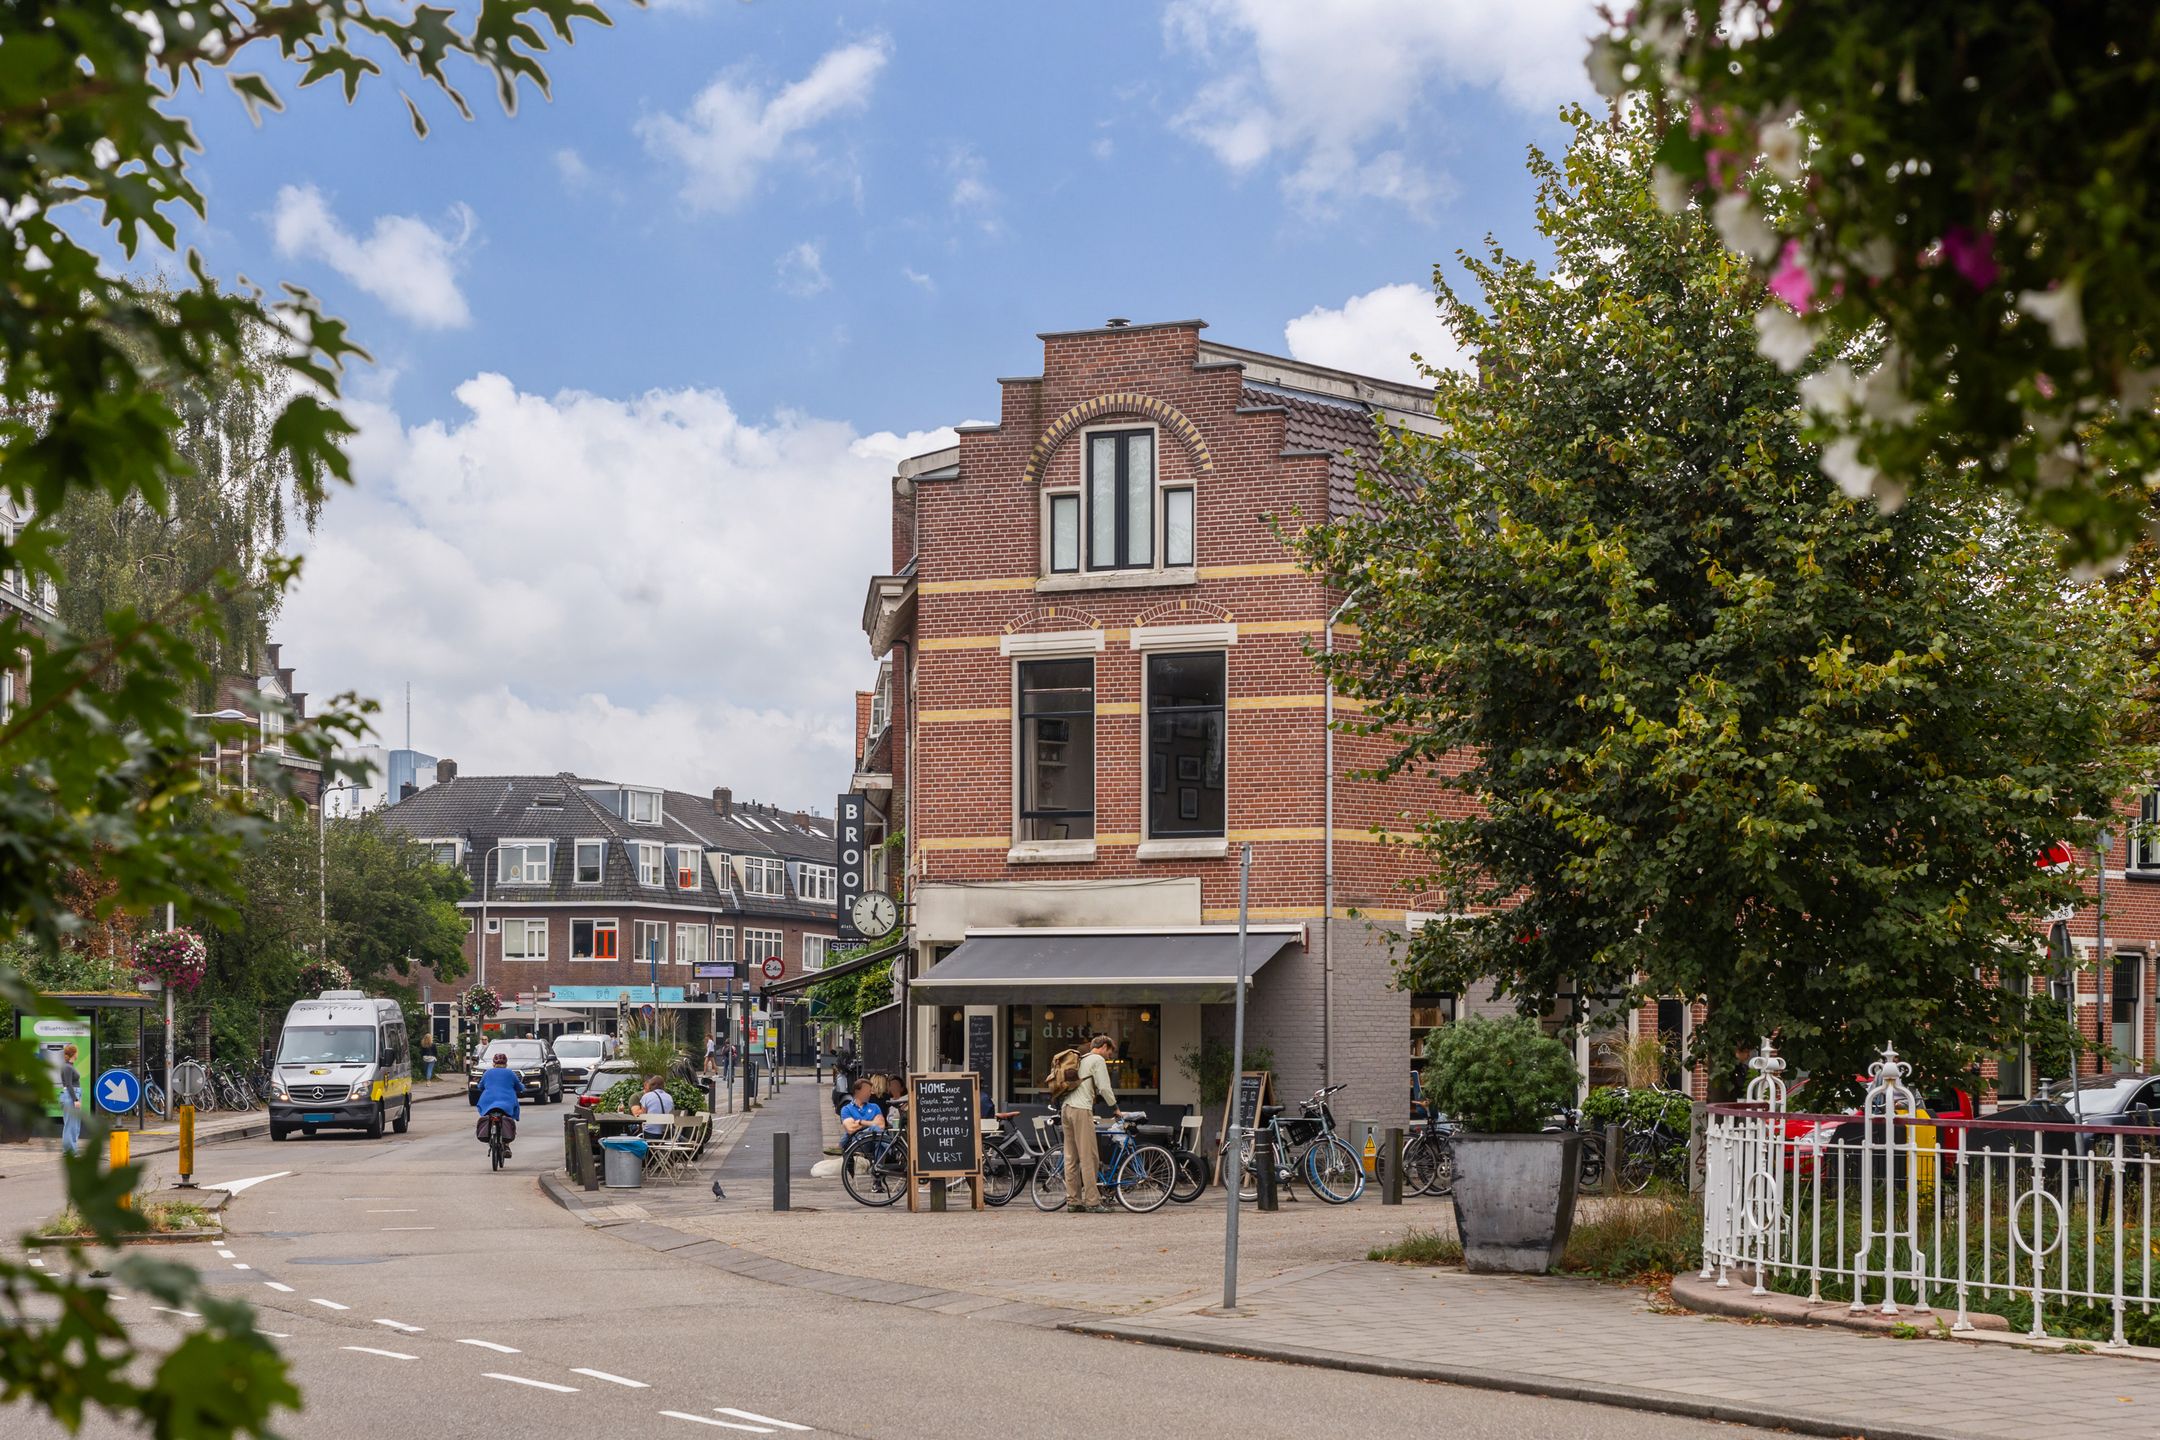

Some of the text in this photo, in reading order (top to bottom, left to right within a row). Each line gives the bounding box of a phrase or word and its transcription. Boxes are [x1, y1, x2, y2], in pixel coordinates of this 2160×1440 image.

[842, 803, 859, 911] BROOD
[831, 942, 867, 951] SEIKO
[920, 1083, 946, 1094] HOME
[939, 1138, 955, 1147] HET
[927, 1152, 962, 1163] VERST
